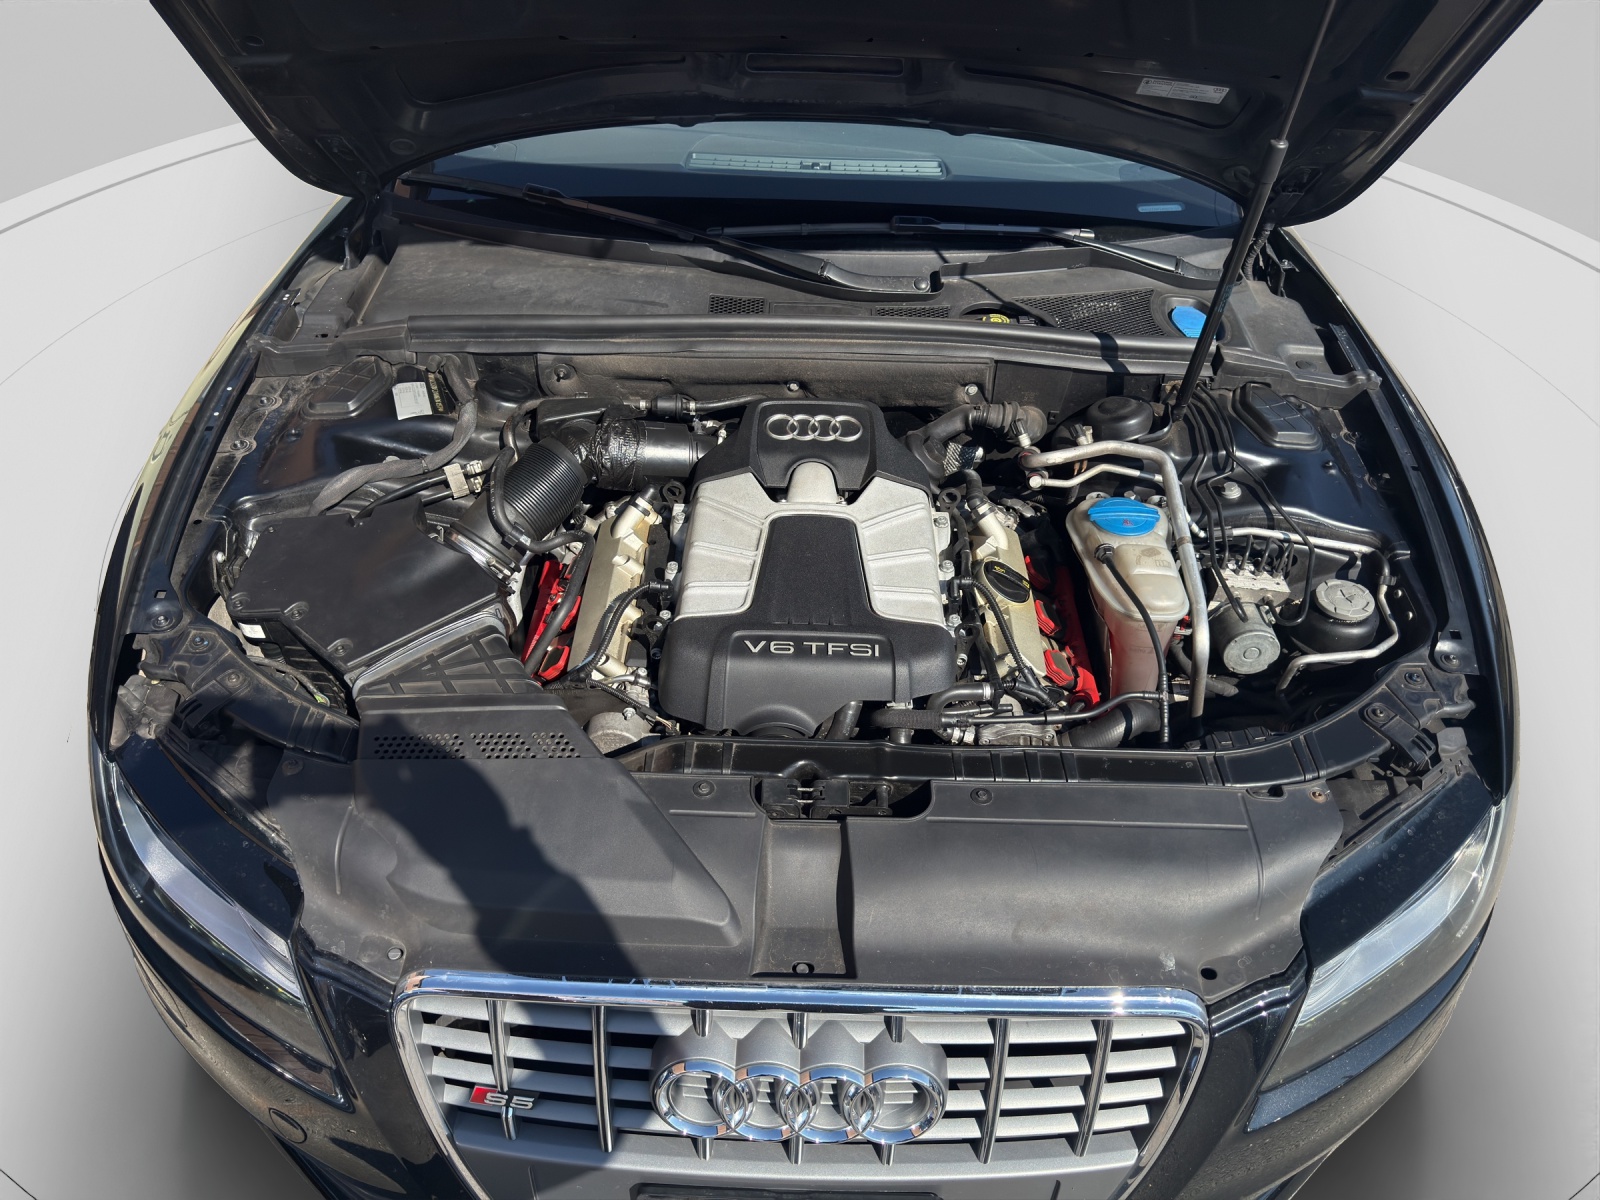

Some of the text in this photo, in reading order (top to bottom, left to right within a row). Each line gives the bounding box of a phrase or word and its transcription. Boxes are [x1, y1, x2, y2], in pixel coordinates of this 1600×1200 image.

[744, 640, 879, 657] V6 TFSI
[484, 1092, 535, 1109] S5
